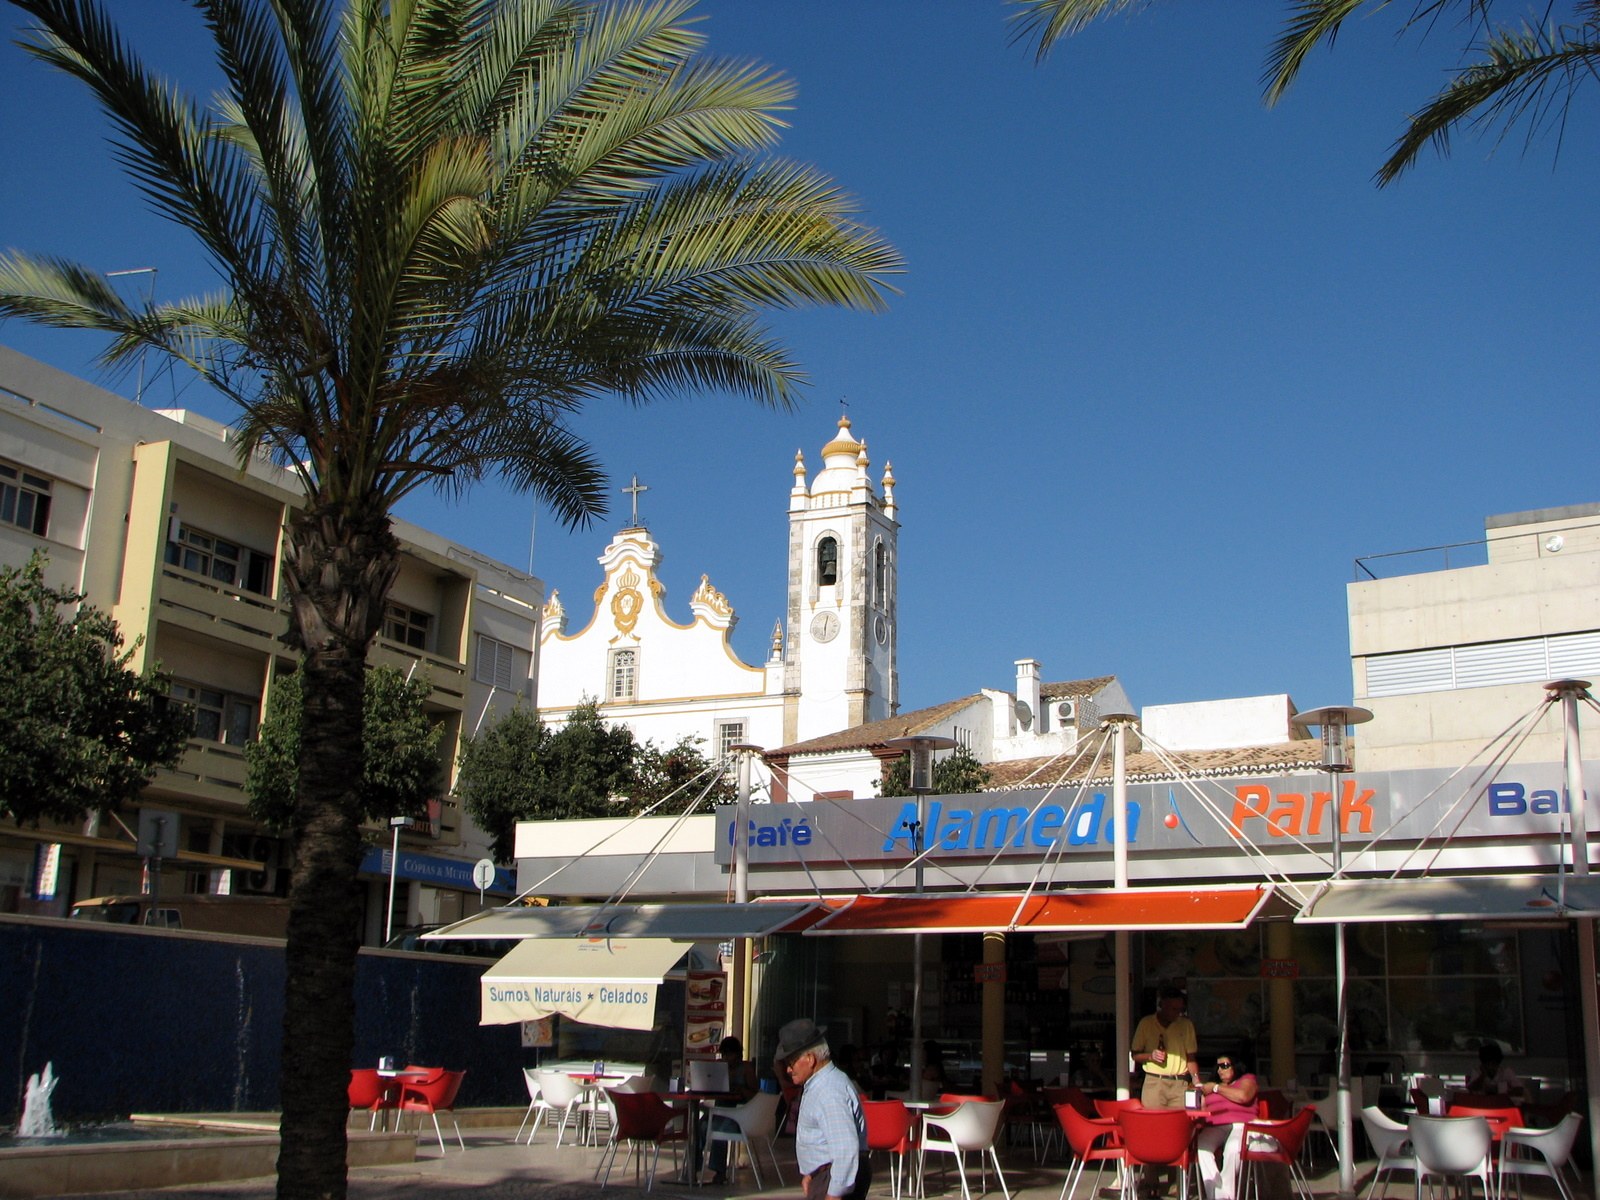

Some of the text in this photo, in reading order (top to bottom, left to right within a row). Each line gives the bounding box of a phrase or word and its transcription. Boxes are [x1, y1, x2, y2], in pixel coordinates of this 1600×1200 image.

[729, 818, 812, 847] Café
[881, 793, 1141, 852] Alameda
[1229, 780, 1376, 838] Park
[436, 867, 443, 876] &
[489, 987, 648, 1004] Sumos Naturais Gelados
